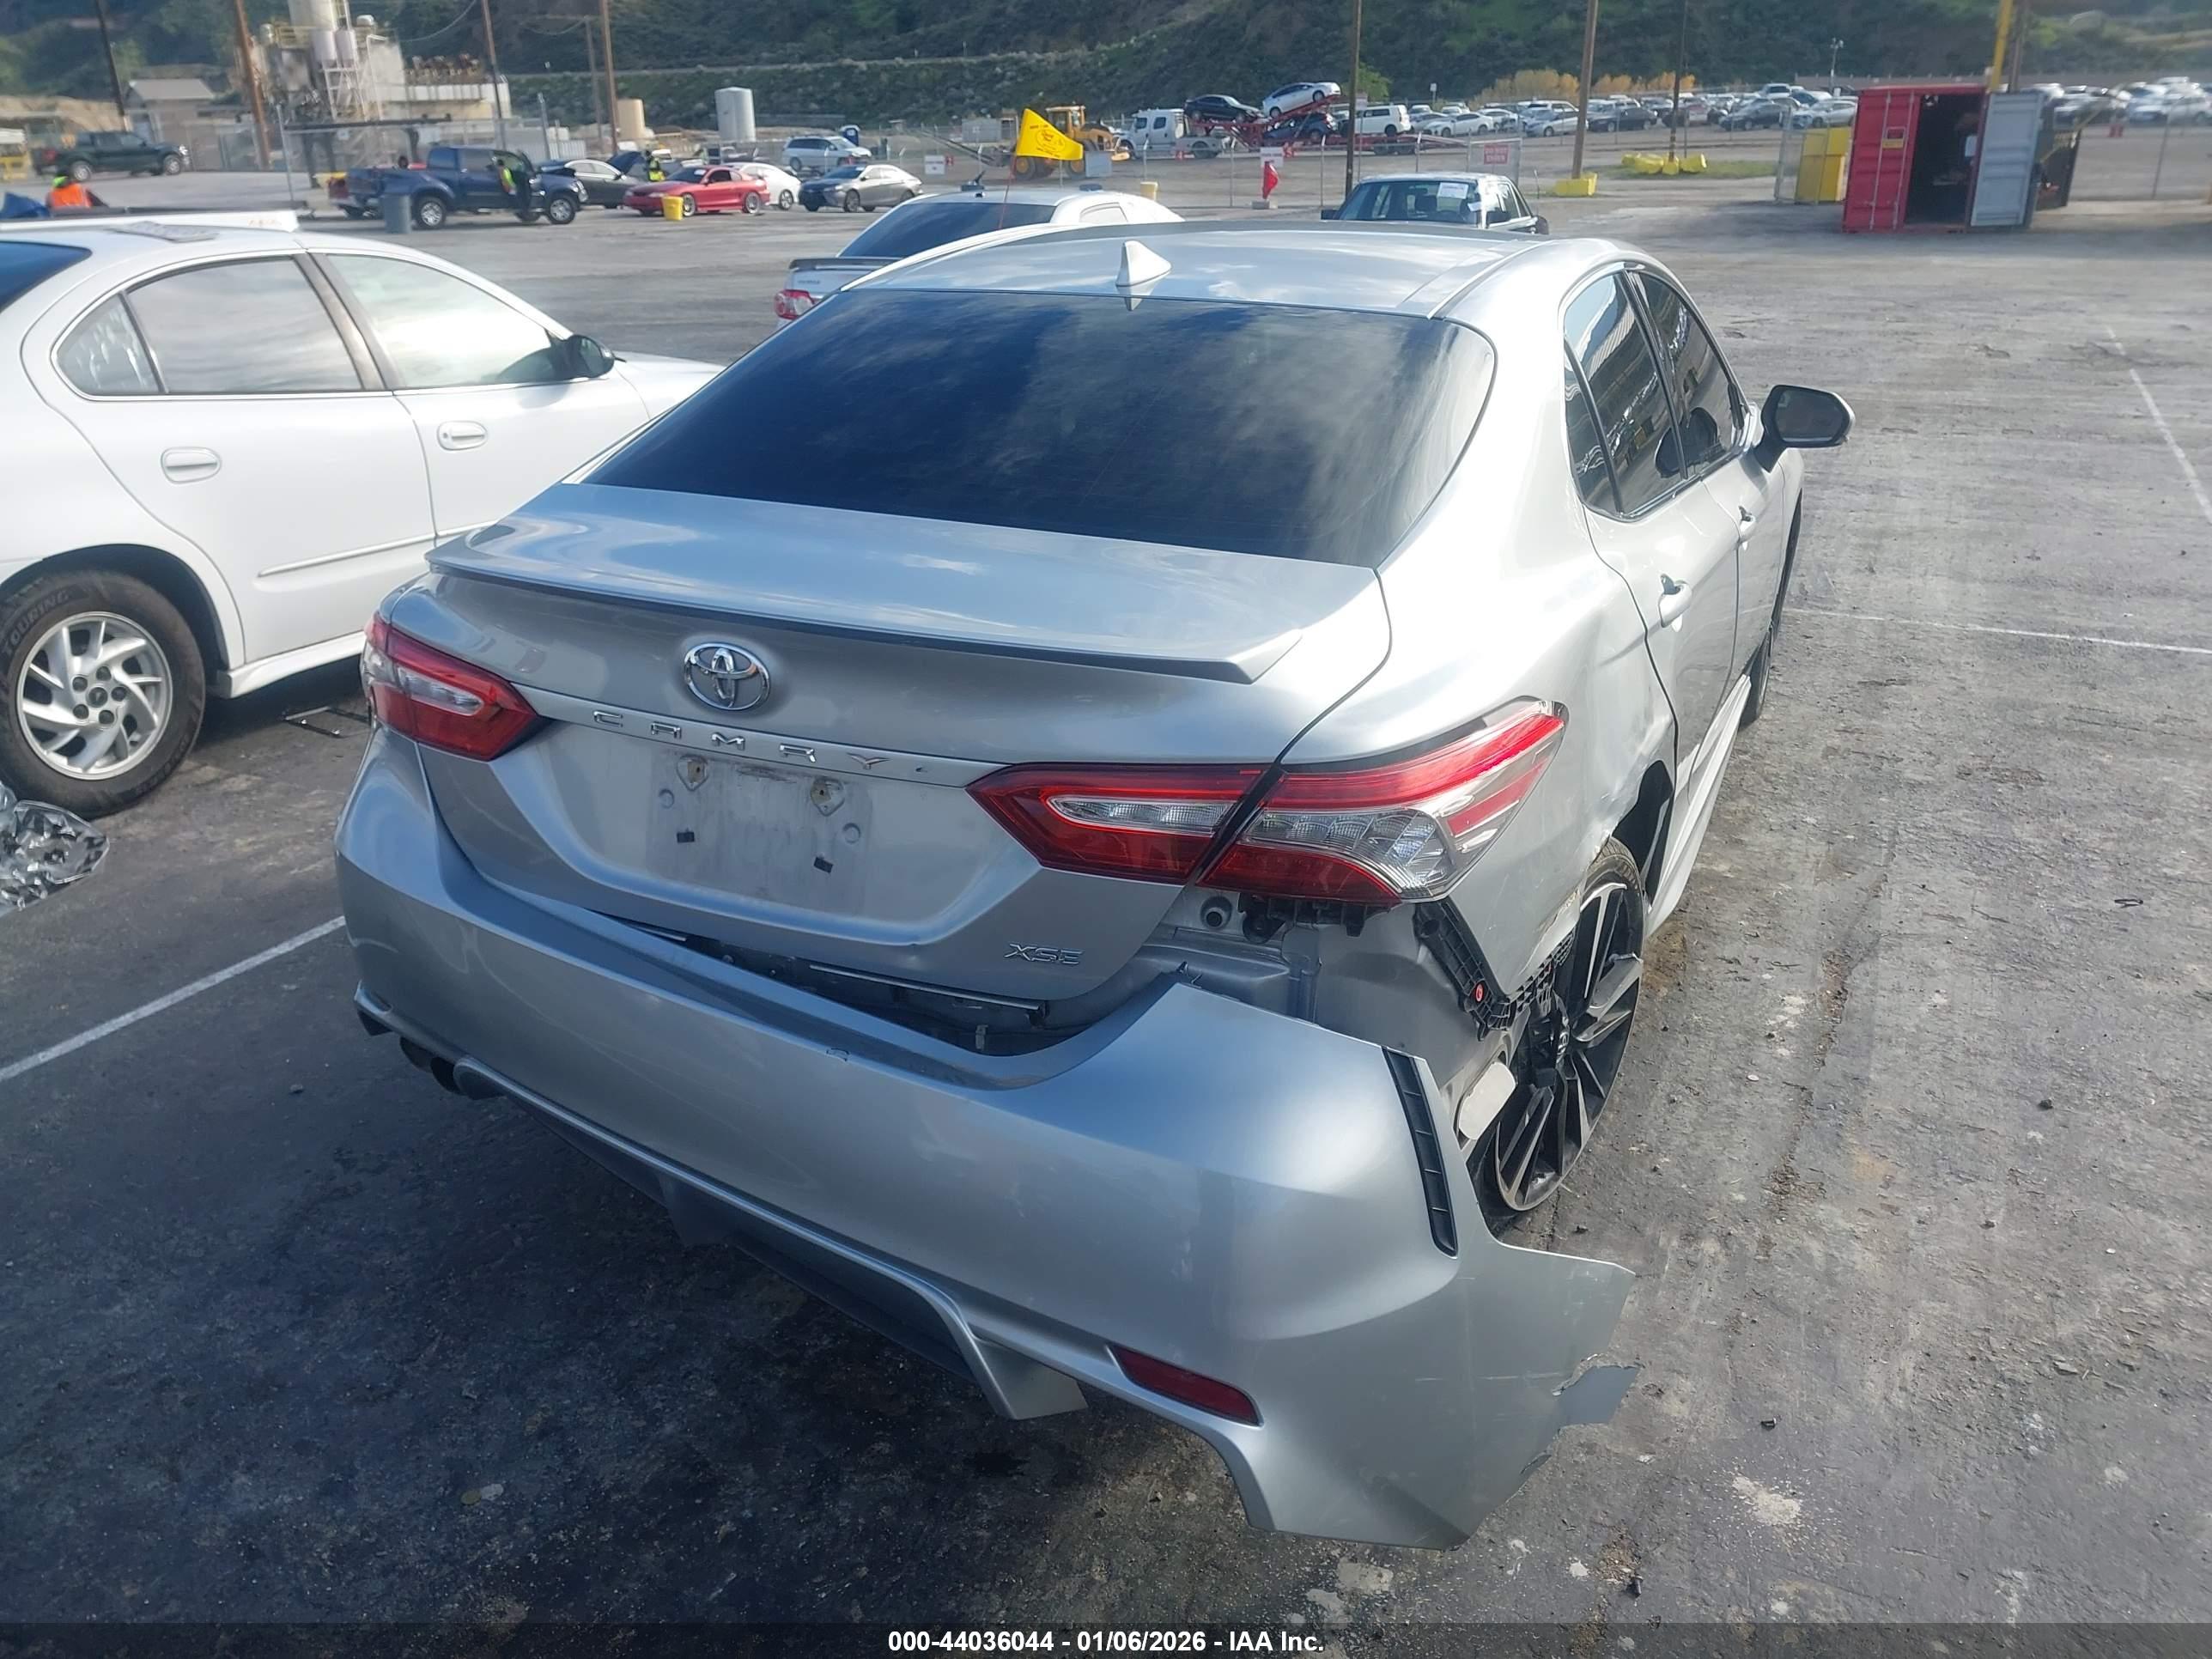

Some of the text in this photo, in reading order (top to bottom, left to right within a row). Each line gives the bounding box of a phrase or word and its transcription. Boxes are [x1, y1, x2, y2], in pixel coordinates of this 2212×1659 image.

[2, 590, 70, 656] TOURING
[593, 710, 890, 770] CAMRY
[1004, 943, 1084, 964] XSE
